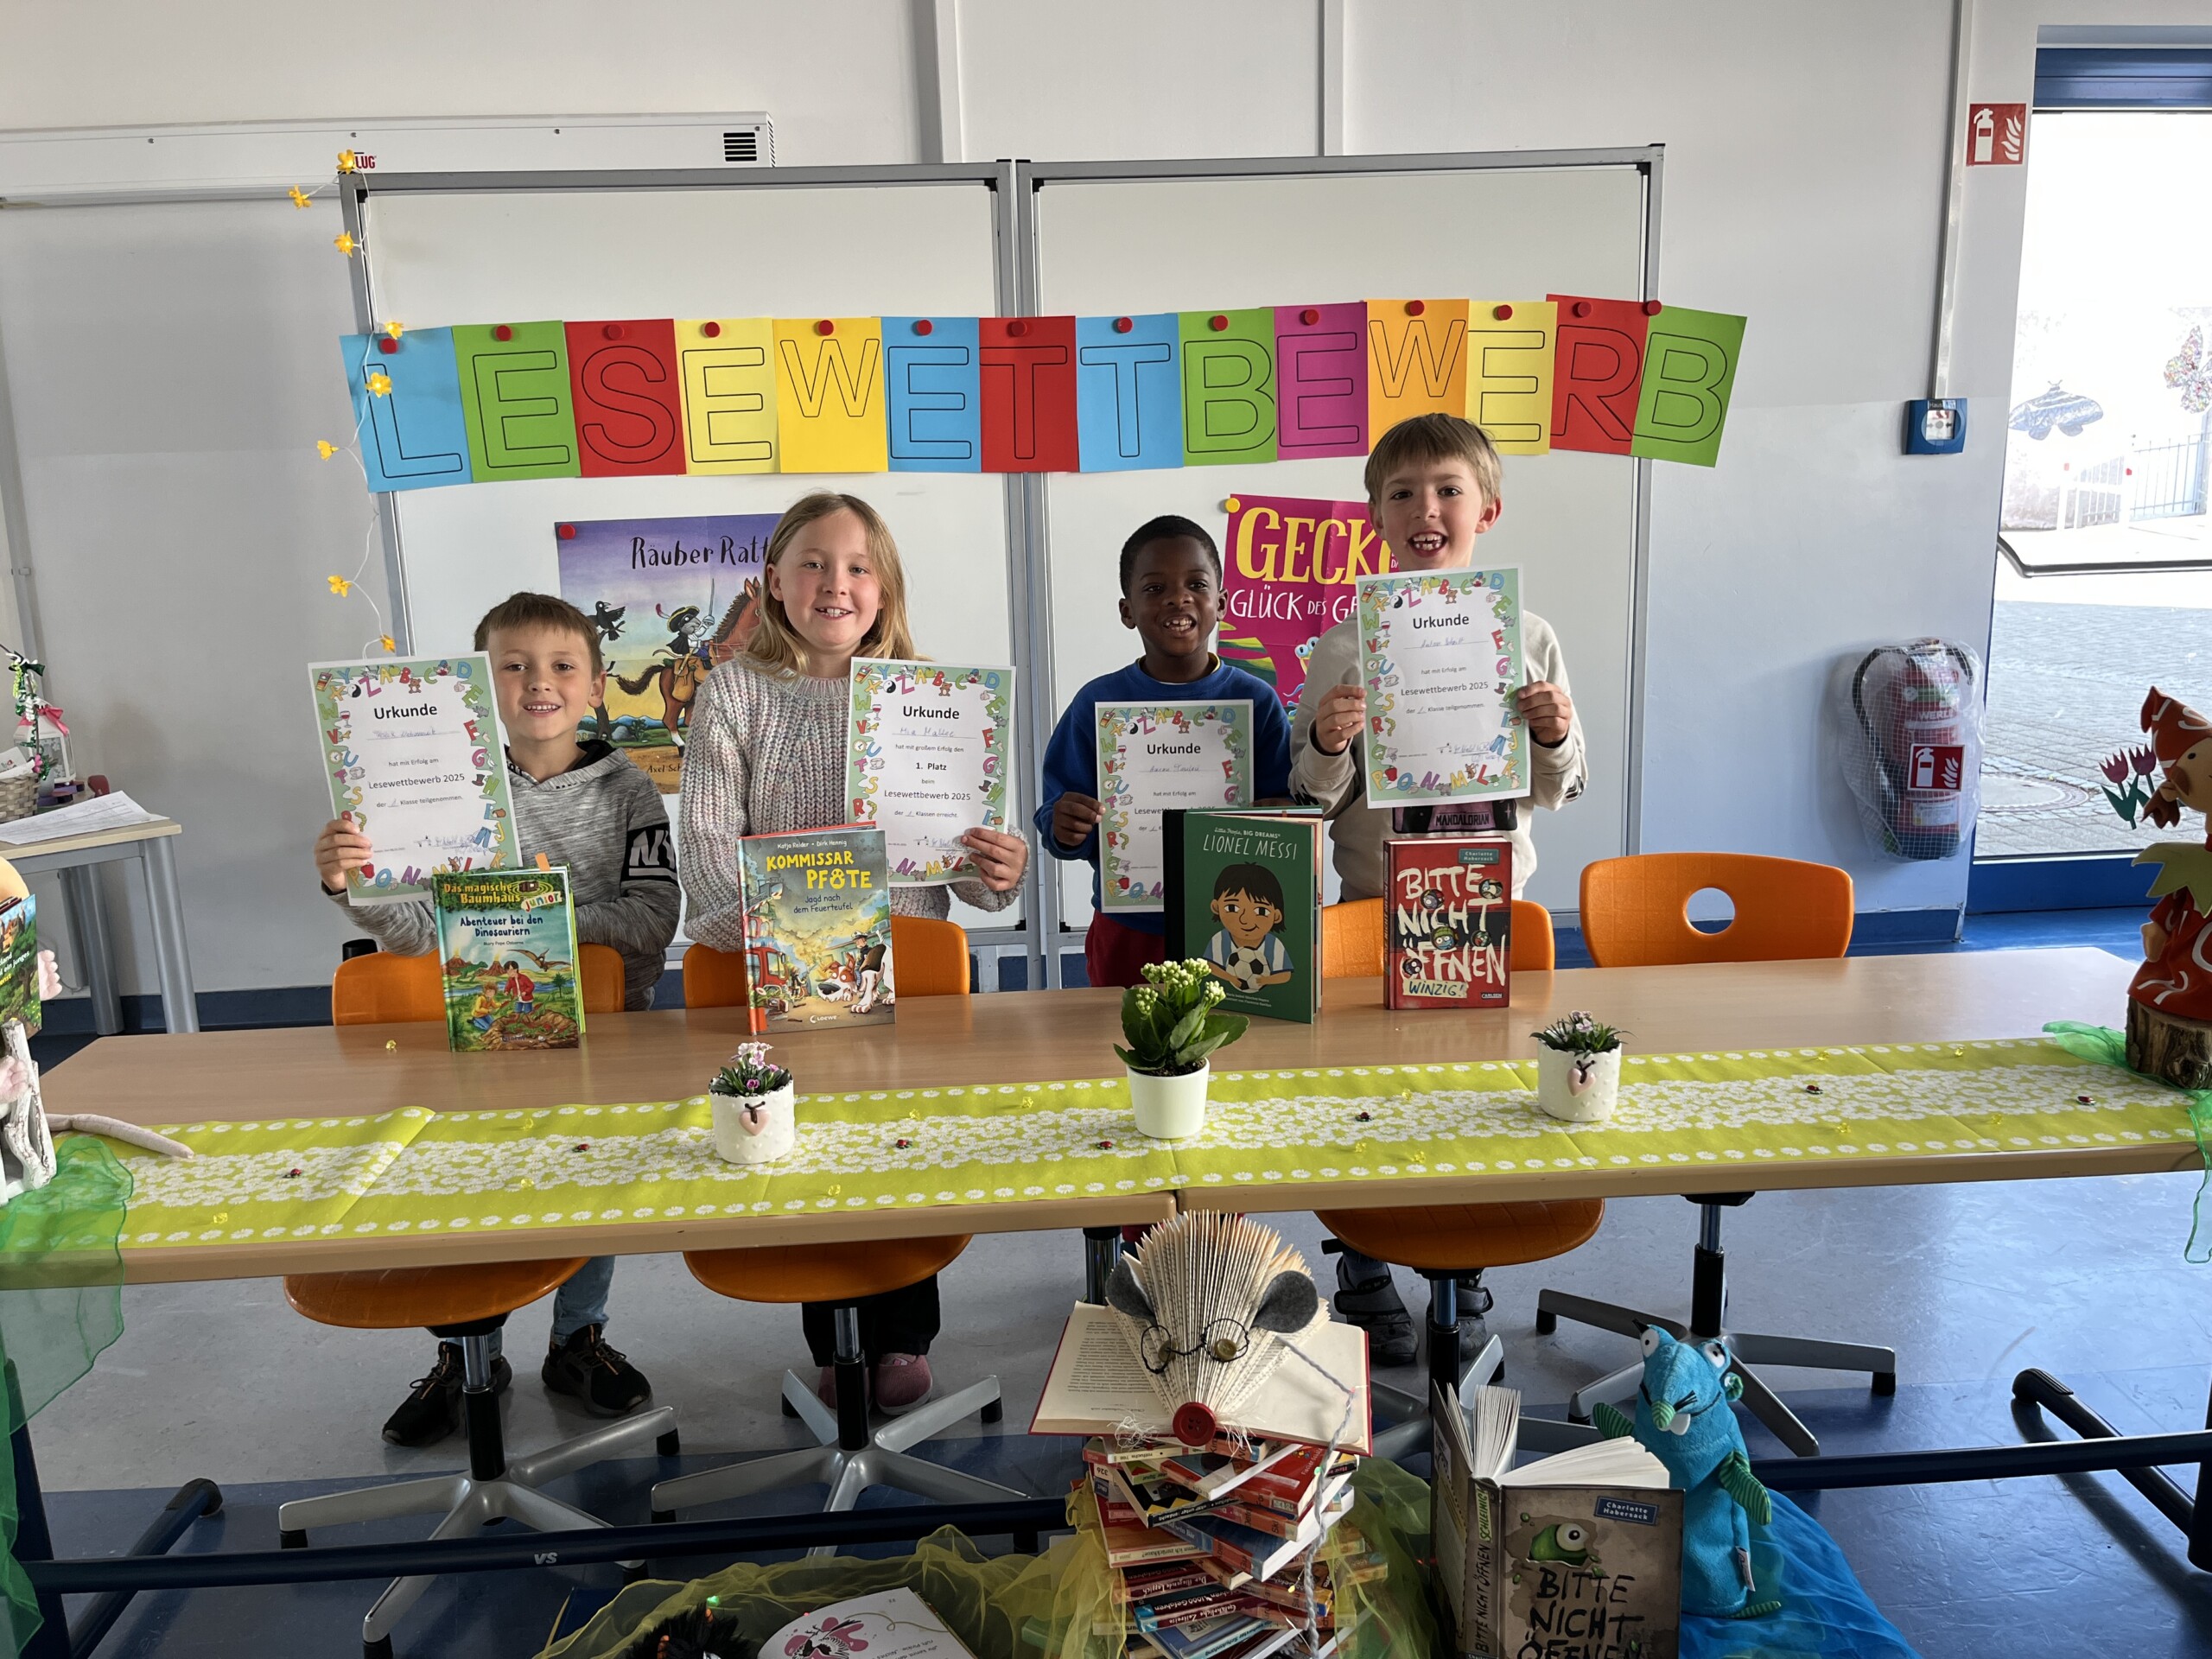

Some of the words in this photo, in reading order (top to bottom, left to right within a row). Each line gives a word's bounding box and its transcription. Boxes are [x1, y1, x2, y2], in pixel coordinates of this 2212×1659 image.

[632, 536, 714, 569] Räuber
[720, 534, 769, 566] Ratt
[1230, 584, 1304, 621] GLÜCK
[1307, 600, 1326, 615] DES
[1413, 613, 1470, 629] Urkunde
[1401, 683, 1468, 696] Lesewettbewerb
[1468, 681, 1489, 690] 2025
[373, 703, 438, 721] Urkunde
[903, 705, 960, 720] Urkunde
[1147, 742, 1202, 755] Urkunde
[927, 762, 947, 771] Platz
[368, 775, 442, 790] Lesewettbewerb
[443, 773, 466, 783] 2025
[884, 790, 950, 800] Lesewettbewerb
[950, 792, 971, 801] 2025
[1435, 812, 1490, 827] MANDALORIAN
[829, 838, 848, 848] Hennig
[1203, 834, 1249, 855] LIONEL
[1255, 840, 1298, 861] MESSI
[766, 850, 855, 872] KOMMISSAR
[443, 883, 462, 893] Das
[465, 881, 513, 895] magische
[1396, 864, 1486, 899] BITTE
[460, 891, 522, 904] Baumhaus
[804, 895, 822, 906] Jagd
[823, 893, 841, 902] nach
[810, 903, 853, 912] Feuerteufel
[460, 916, 507, 927] Abenteuer
[510, 914, 524, 925] bei
[527, 912, 543, 925] den
[1396, 898, 1503, 937] NICHT
[475, 925, 531, 937] Dinosauriern
[12, 950, 30, 969] junges
[1096, 1467, 1109, 1476] 326
[1603, 1508, 1649, 1521] Habersack
[1606, 1502, 1649, 1514] Charlotte
[1159, 1512, 1179, 1521] erdacht
[533, 1552, 557, 1565] VS
[1473, 1543, 1491, 1587] ÖFFNEN
[1194, 1575, 1207, 1584] Der
[1536, 1567, 1636, 1604] BITTE
[1154, 1599, 1188, 1611] Gefahren
[1187, 1596, 1205, 1605] 1000
[1476, 1587, 1490, 1618] NICHT
[1199, 1605, 1236, 1616] Gefährliche
[1169, 1613, 1198, 1624] Zeitreise
[1529, 1600, 1645, 1643] NICHT
[1475, 1618, 1490, 1653] BITTE
